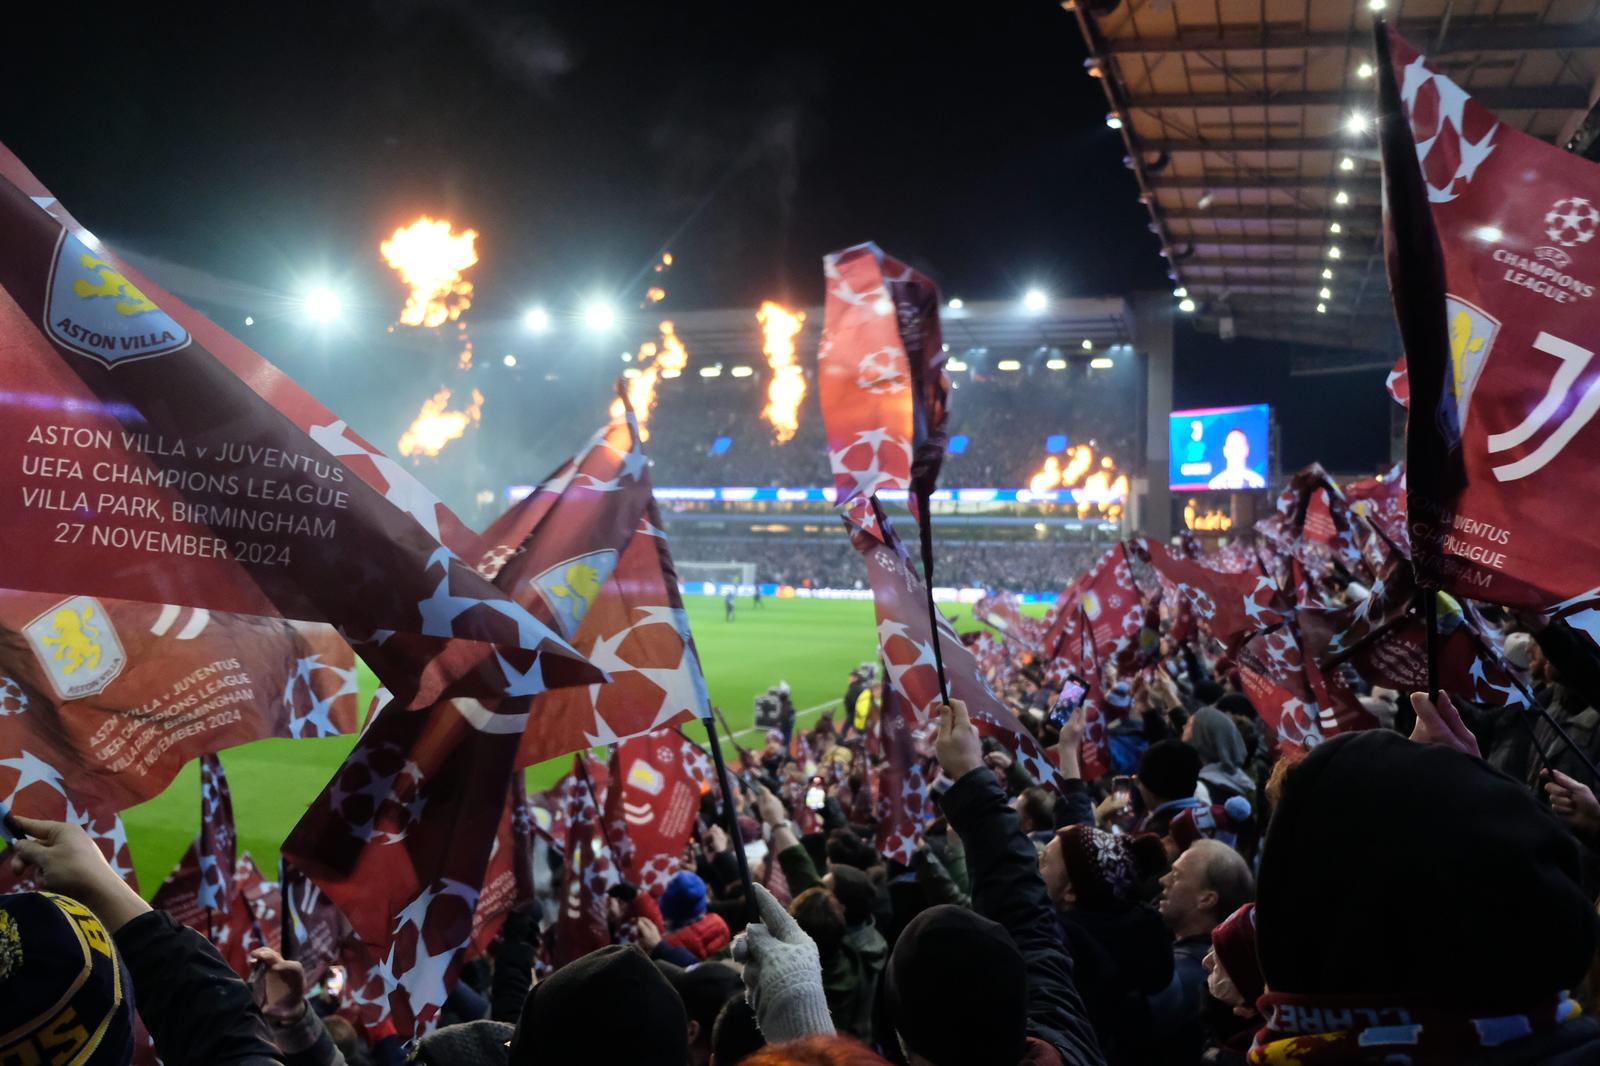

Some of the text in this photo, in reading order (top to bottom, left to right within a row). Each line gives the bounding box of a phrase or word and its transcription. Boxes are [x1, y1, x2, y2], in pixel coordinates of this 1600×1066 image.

[1492, 249, 1596, 298] CHAMPIONS
[1503, 269, 1569, 304] LEAGUE
[57, 317, 175, 351] ASTON VILLA
[27, 425, 112, 450] ASTON
[121, 432, 186, 457] VILLA
[215, 442, 344, 482] JUVENTUS
[22, 455, 349, 509] UEFA CHAMPIONS LEAGUE
[21, 487, 336, 539] VILLA PARK, BIRMINGHAM
[54, 523, 291, 567] 27 NOVEMBER 2024
[121, 698, 162, 719] VILLA
[173, 657, 241, 695] JUVENTUS
[199, 672, 252, 699] LEAGUE
[163, 689, 255, 730] BIRMINGHAM
[207, 709, 242, 729] 2024
